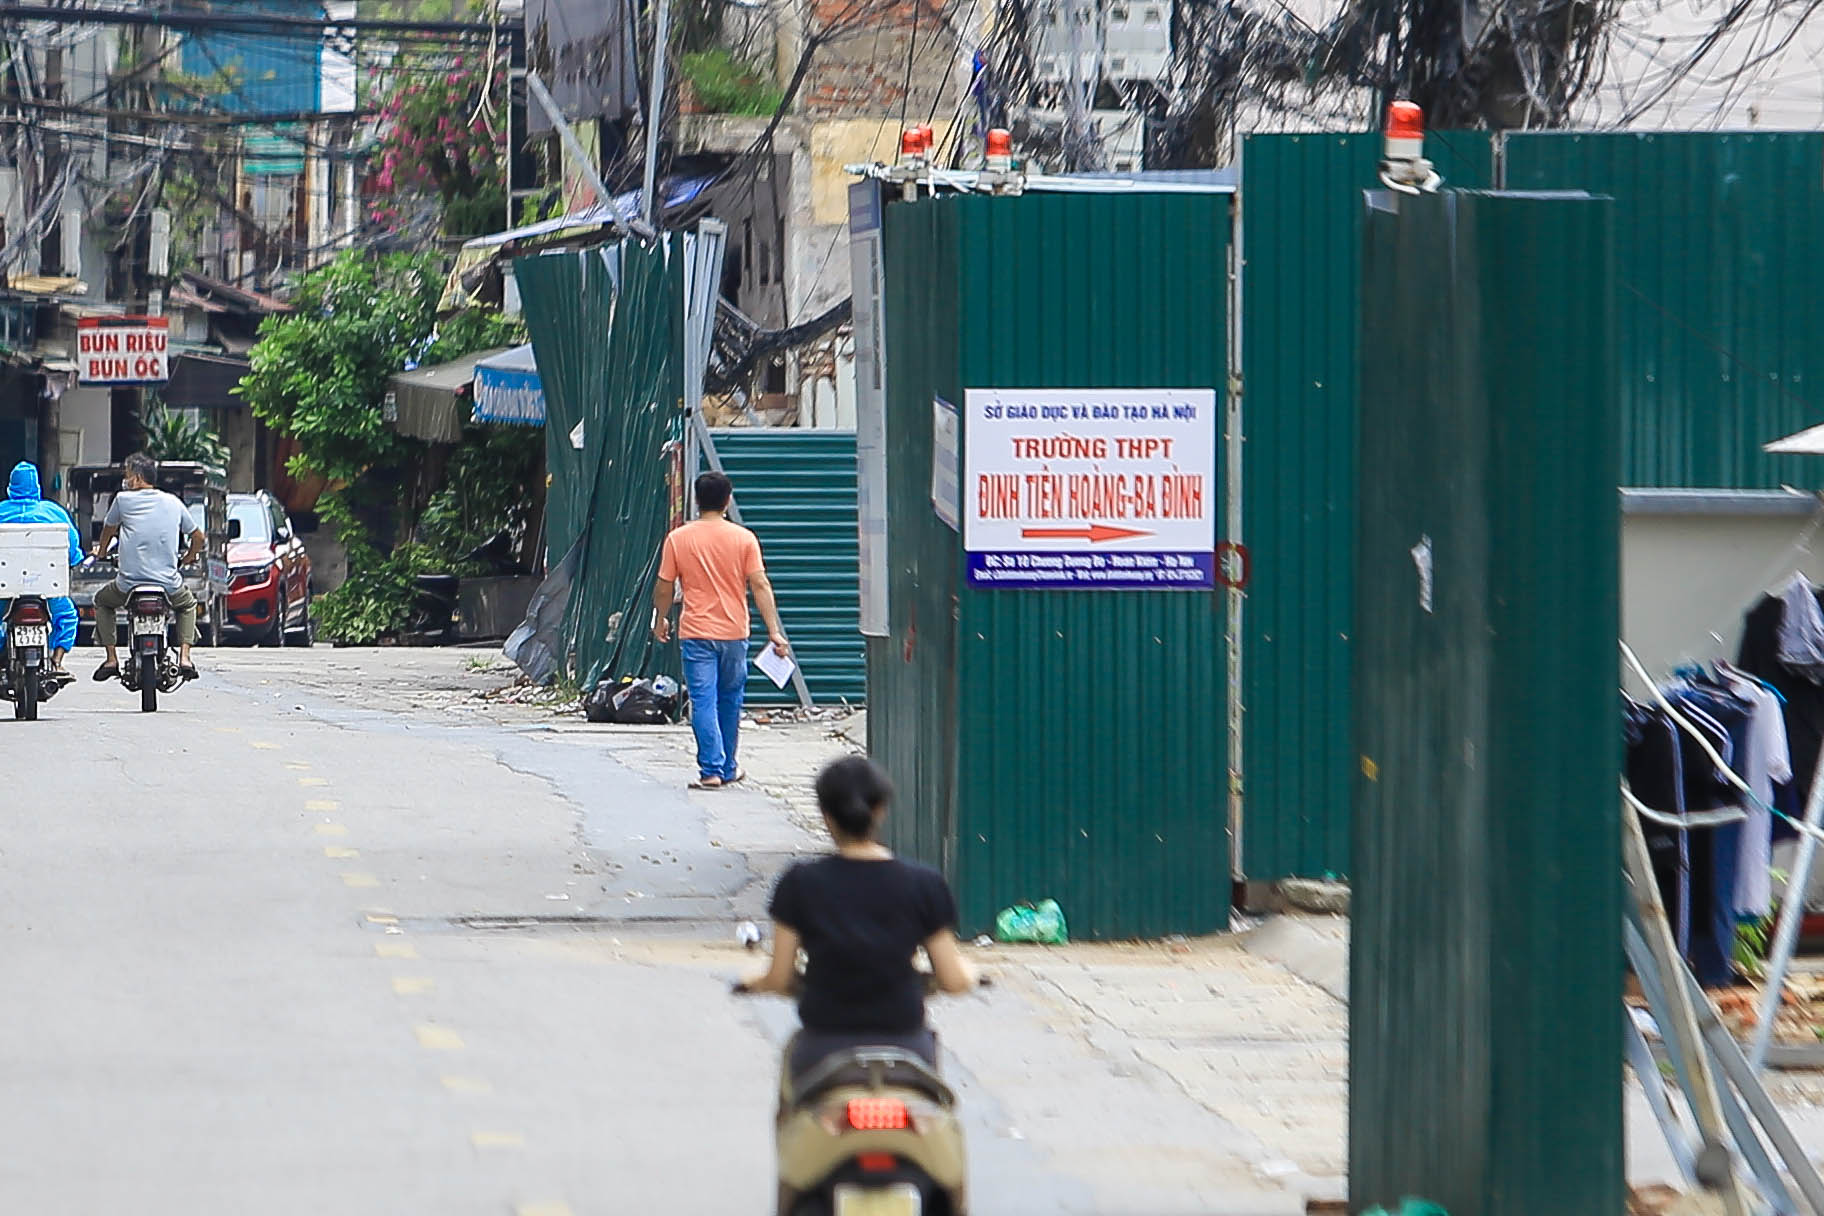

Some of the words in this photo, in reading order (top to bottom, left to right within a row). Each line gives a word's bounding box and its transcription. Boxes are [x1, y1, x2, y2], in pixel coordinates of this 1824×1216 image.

[79, 331, 118, 352] BÚN
[89, 353, 128, 378] BÚN
[984, 399, 1002, 420] SỞ
[1006, 401, 1037, 420] GIÁO
[1041, 404, 1068, 423] DỤC
[1072, 401, 1090, 420] VÀ
[1123, 404, 1148, 423] TẠO
[1012, 431, 1107, 459] TRƯỜNG
[1115, 438, 1174, 459] THPT
